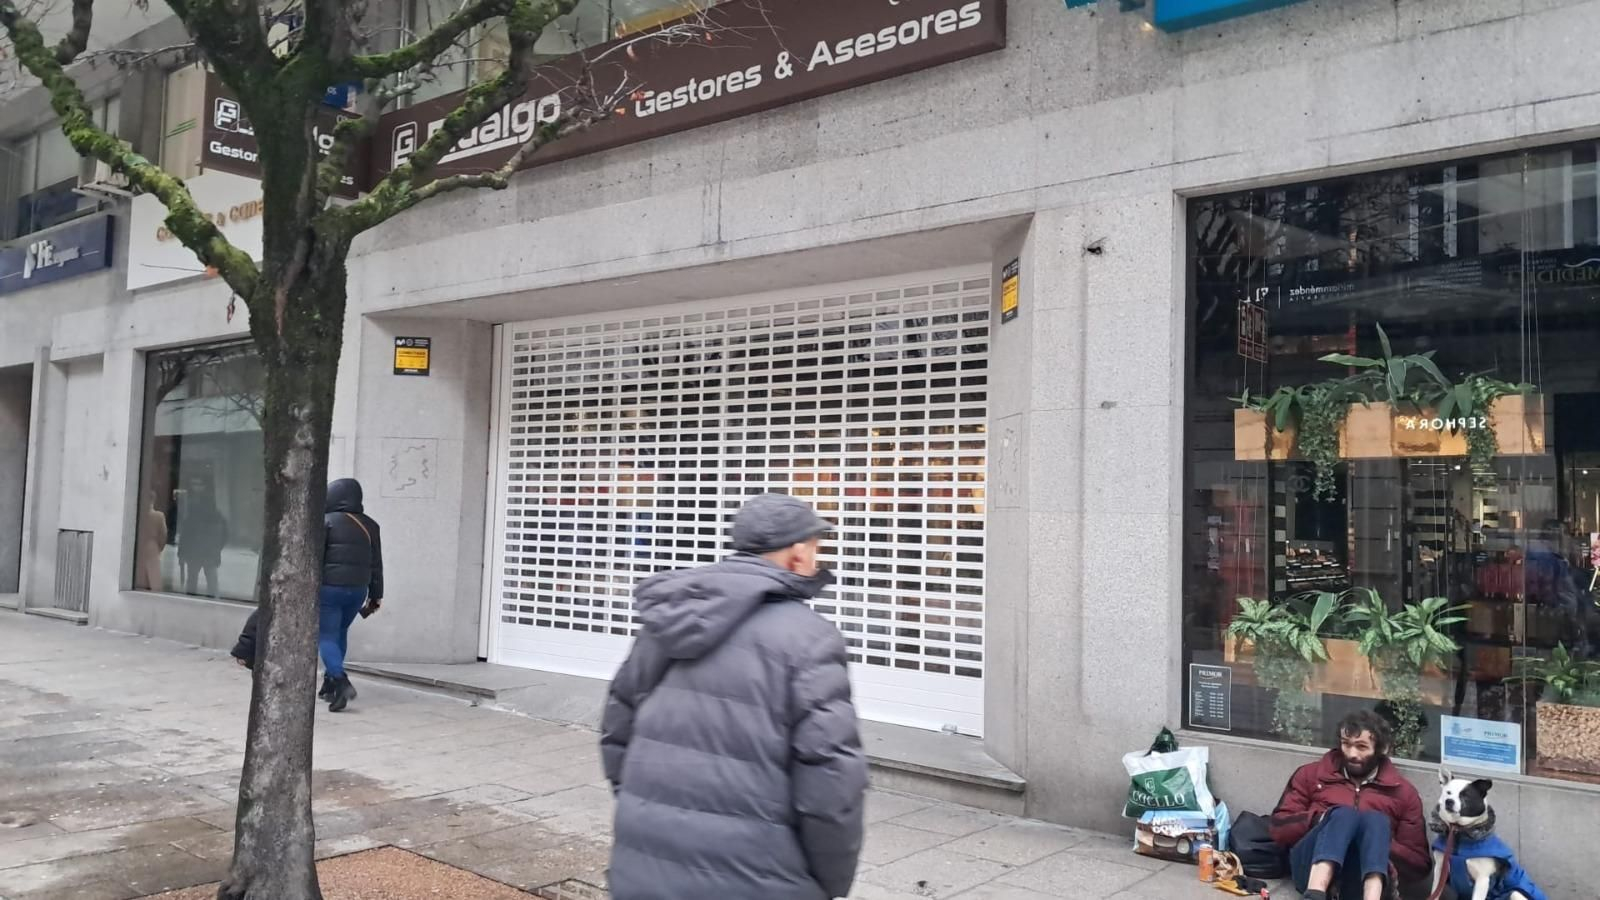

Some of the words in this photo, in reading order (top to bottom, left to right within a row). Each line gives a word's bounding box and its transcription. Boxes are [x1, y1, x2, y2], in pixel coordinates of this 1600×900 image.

[634, 63, 762, 118] Gestores
[774, 51, 793, 80] &
[807, 0, 982, 72] Asesores
[209, 140, 259, 163] Gestor
